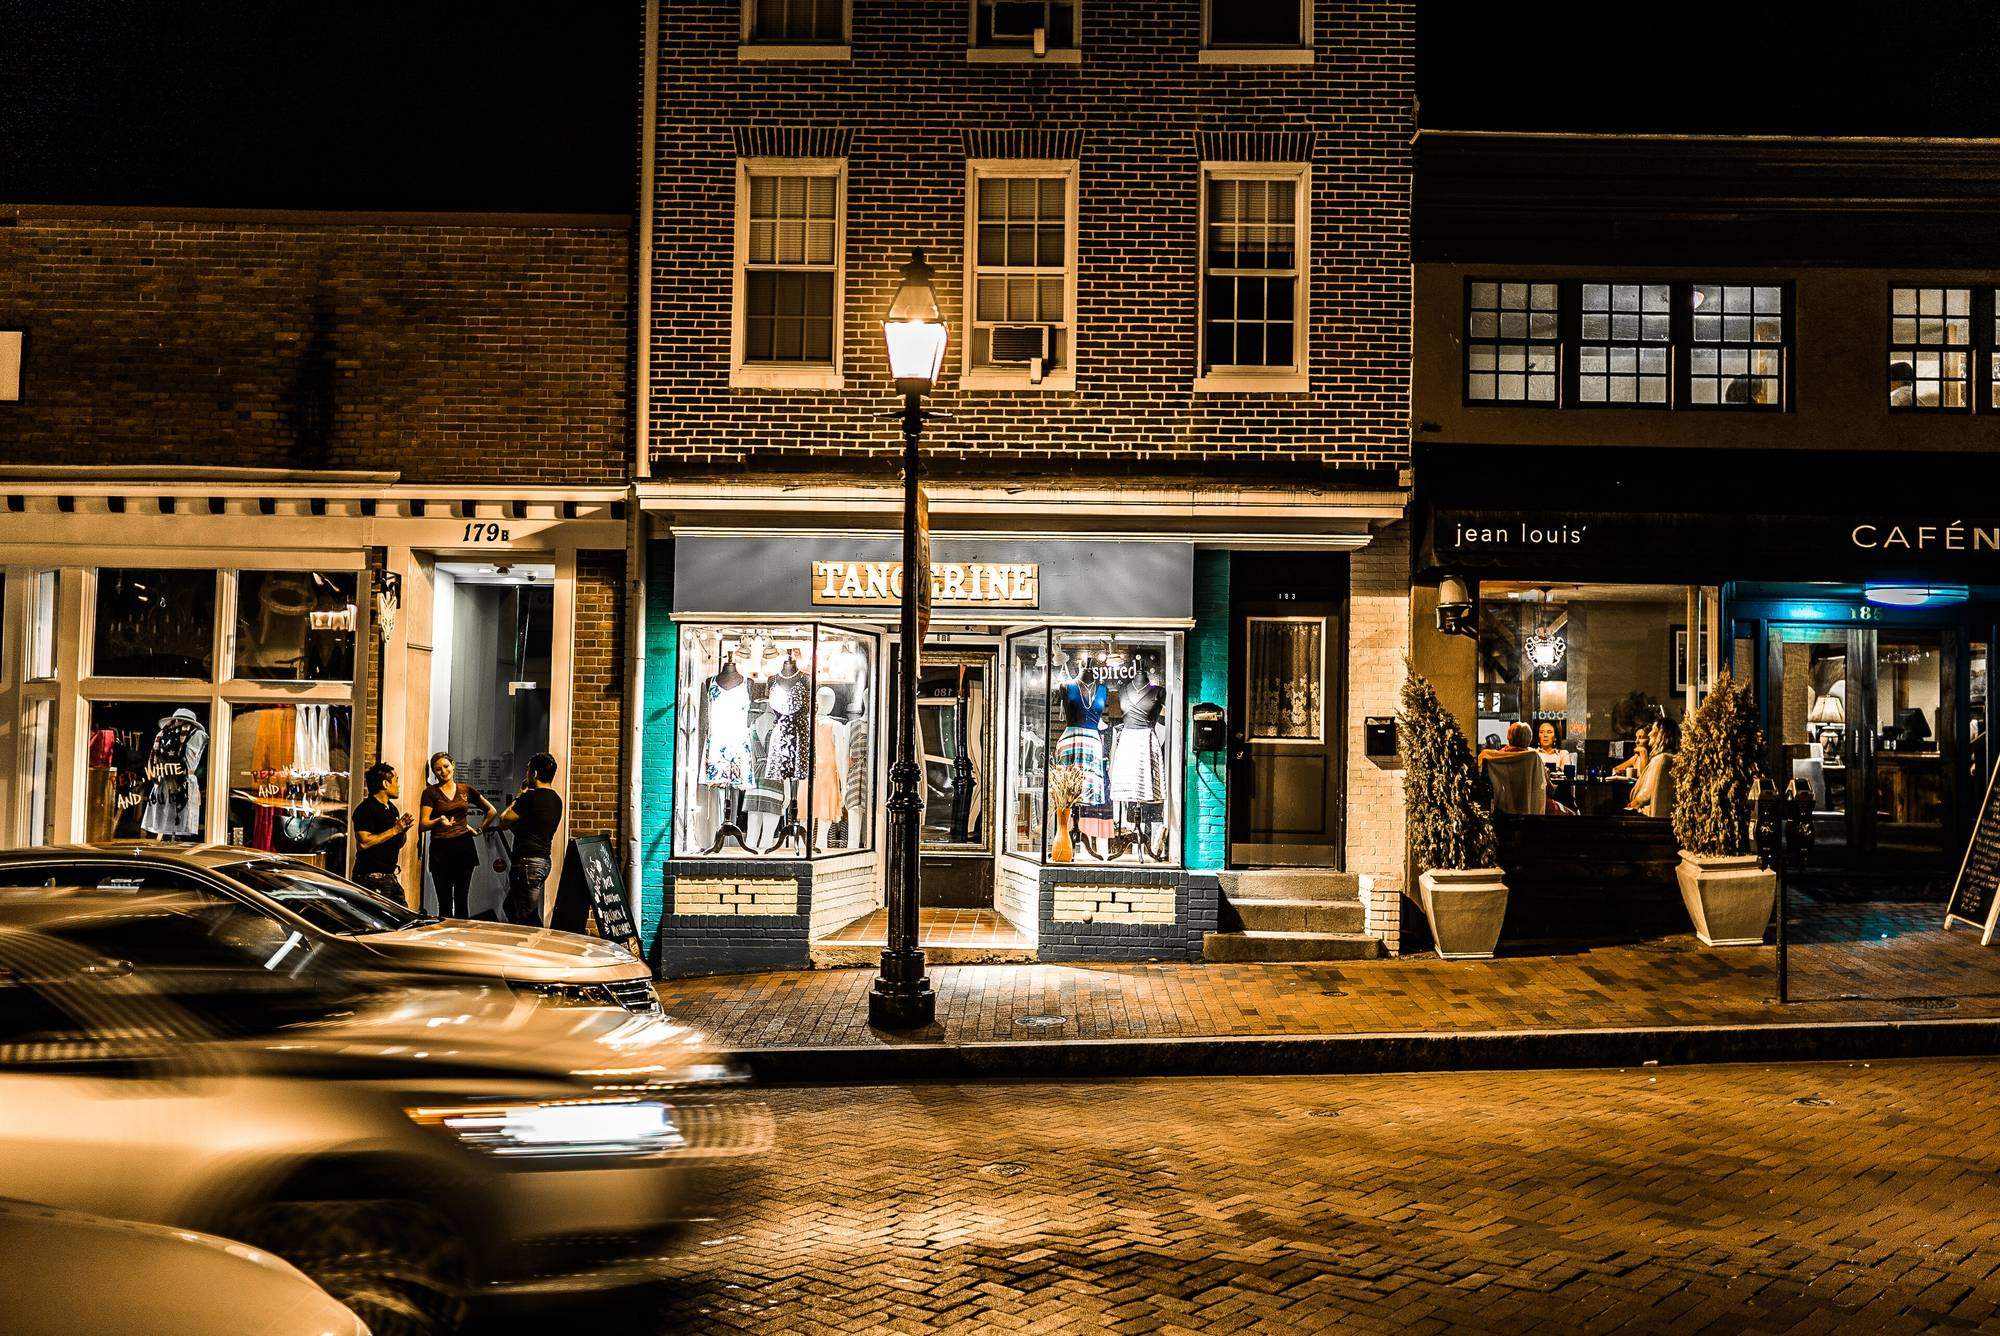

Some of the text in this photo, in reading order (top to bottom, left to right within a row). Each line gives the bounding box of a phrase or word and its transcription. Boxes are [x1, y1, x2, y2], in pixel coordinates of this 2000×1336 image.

[1455, 523, 1508, 547] jean
[258, 783, 280, 798] AND
[117, 792, 142, 810] AND
